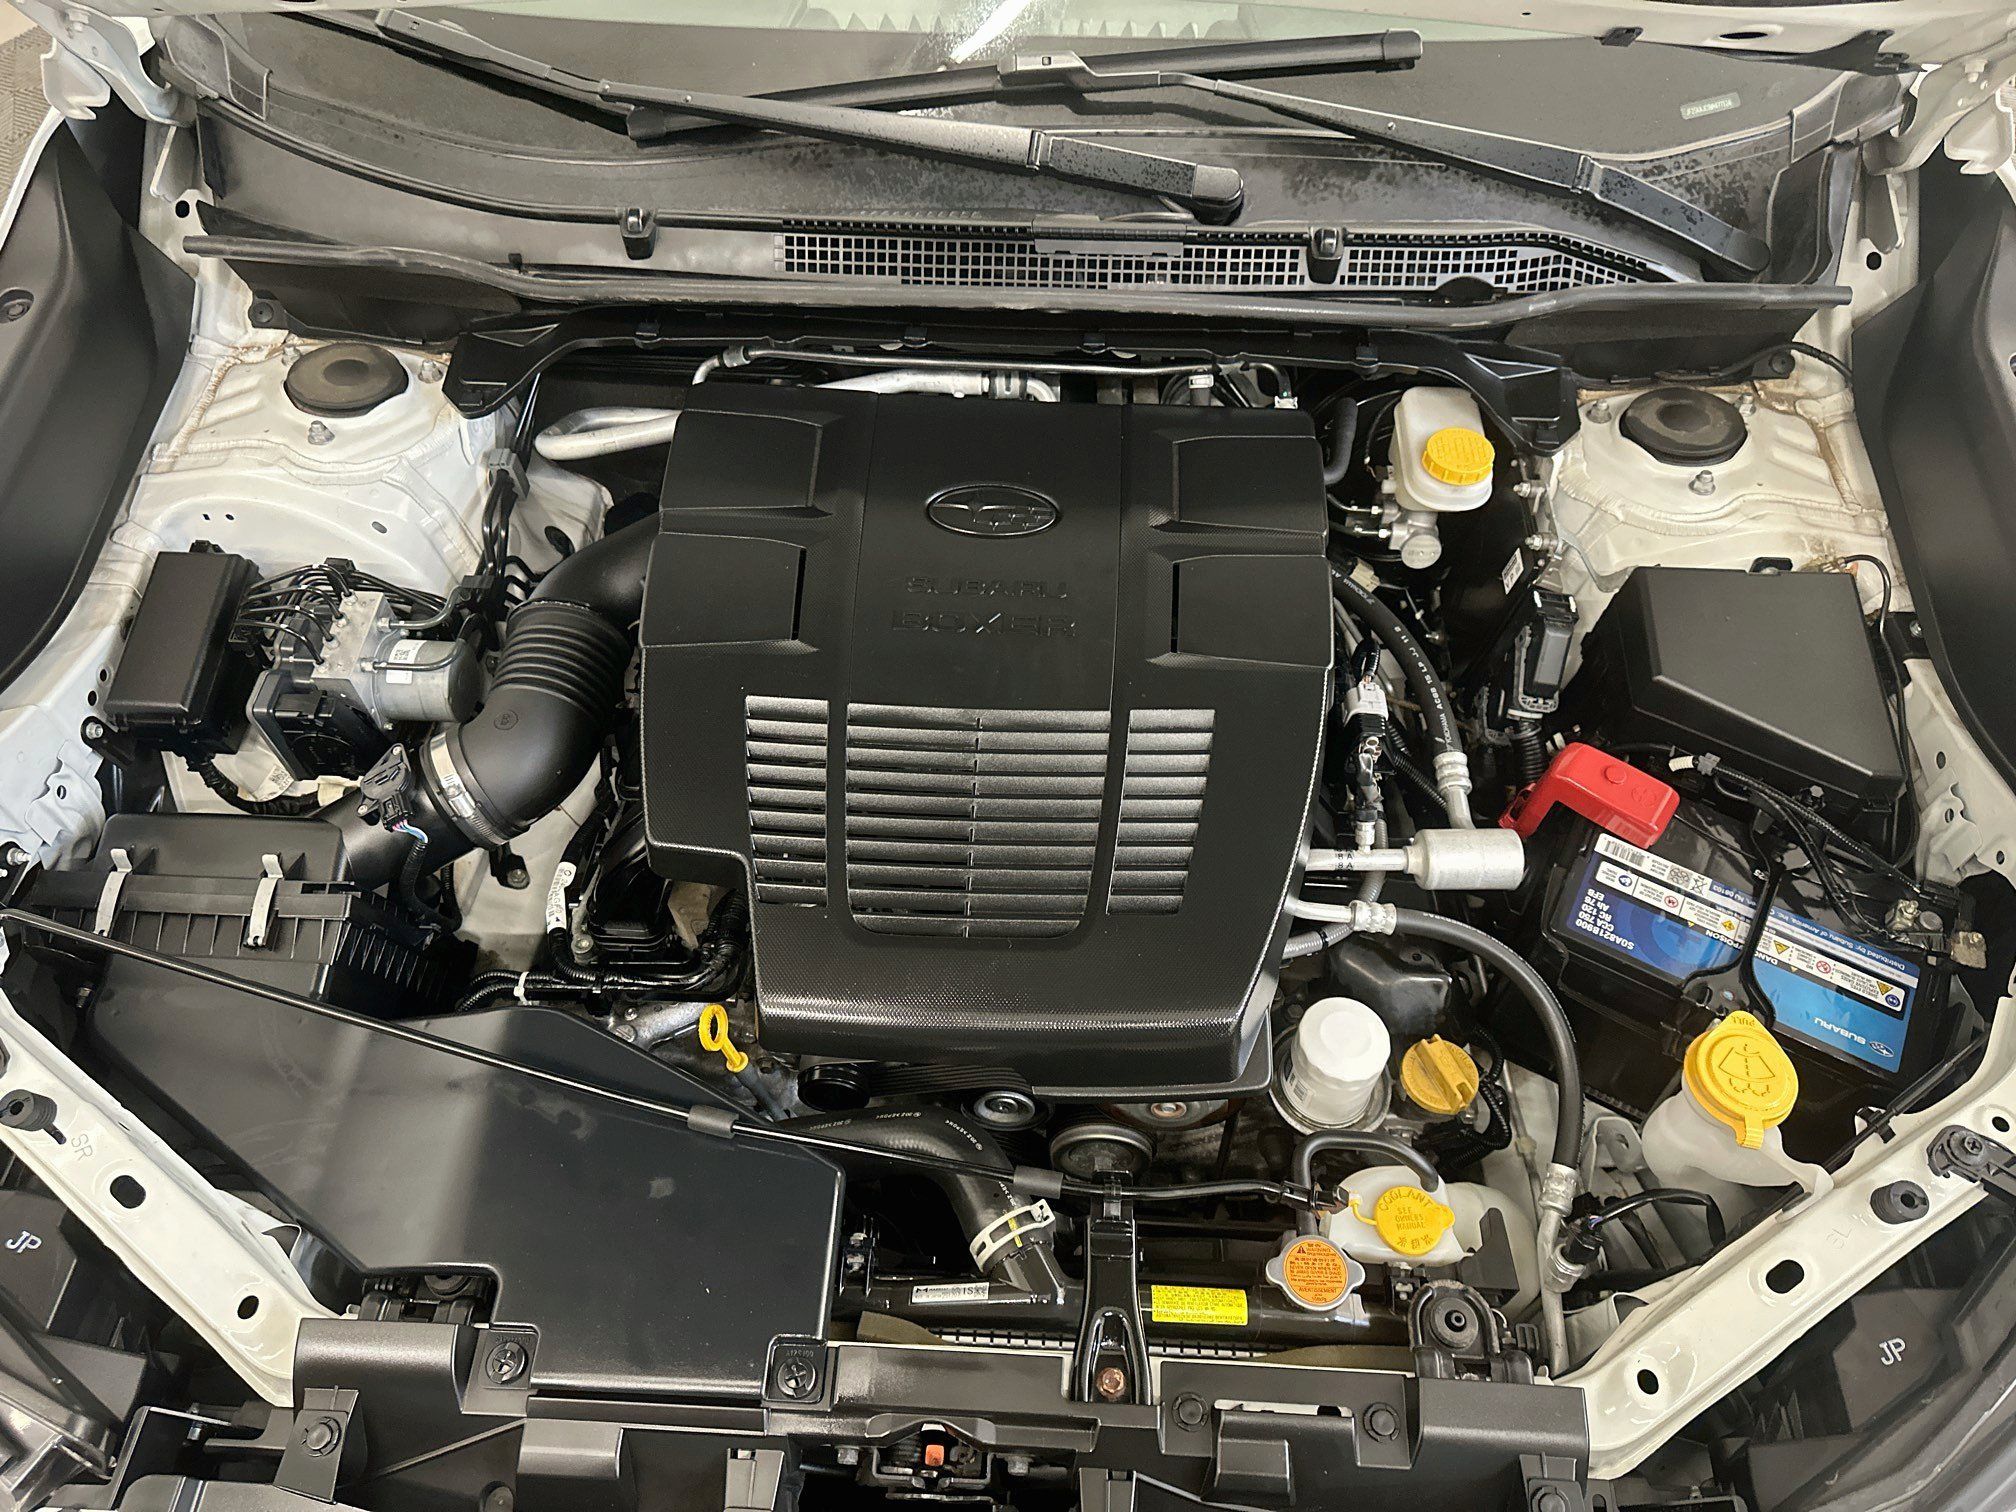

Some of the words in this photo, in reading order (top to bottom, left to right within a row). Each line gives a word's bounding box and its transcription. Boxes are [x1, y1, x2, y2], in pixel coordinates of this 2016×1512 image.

[907, 576, 1068, 599] SUBARU
[893, 611, 1076, 636] BOXER
[1583, 895, 1597, 906] 76
[1586, 888, 1605, 901] EFB
[1581, 902, 1598, 915] 120
[1596, 901, 1610, 912] Ah
[1577, 910, 1596, 924] 750
[1597, 910, 1612, 922] RC
[1595, 918, 1615, 932] CCA
[1828, 934, 1854, 948] Subaru
[1814, 1016, 1866, 1044] SUBARU
[71, 1133, 94, 1161] SR
[1379, 1189, 1433, 1211] COOLANT
[1396, 1222, 1425, 1230] MANUAL
[5, 1230, 42, 1254] JP
[1879, 1338, 1906, 1365] JP
